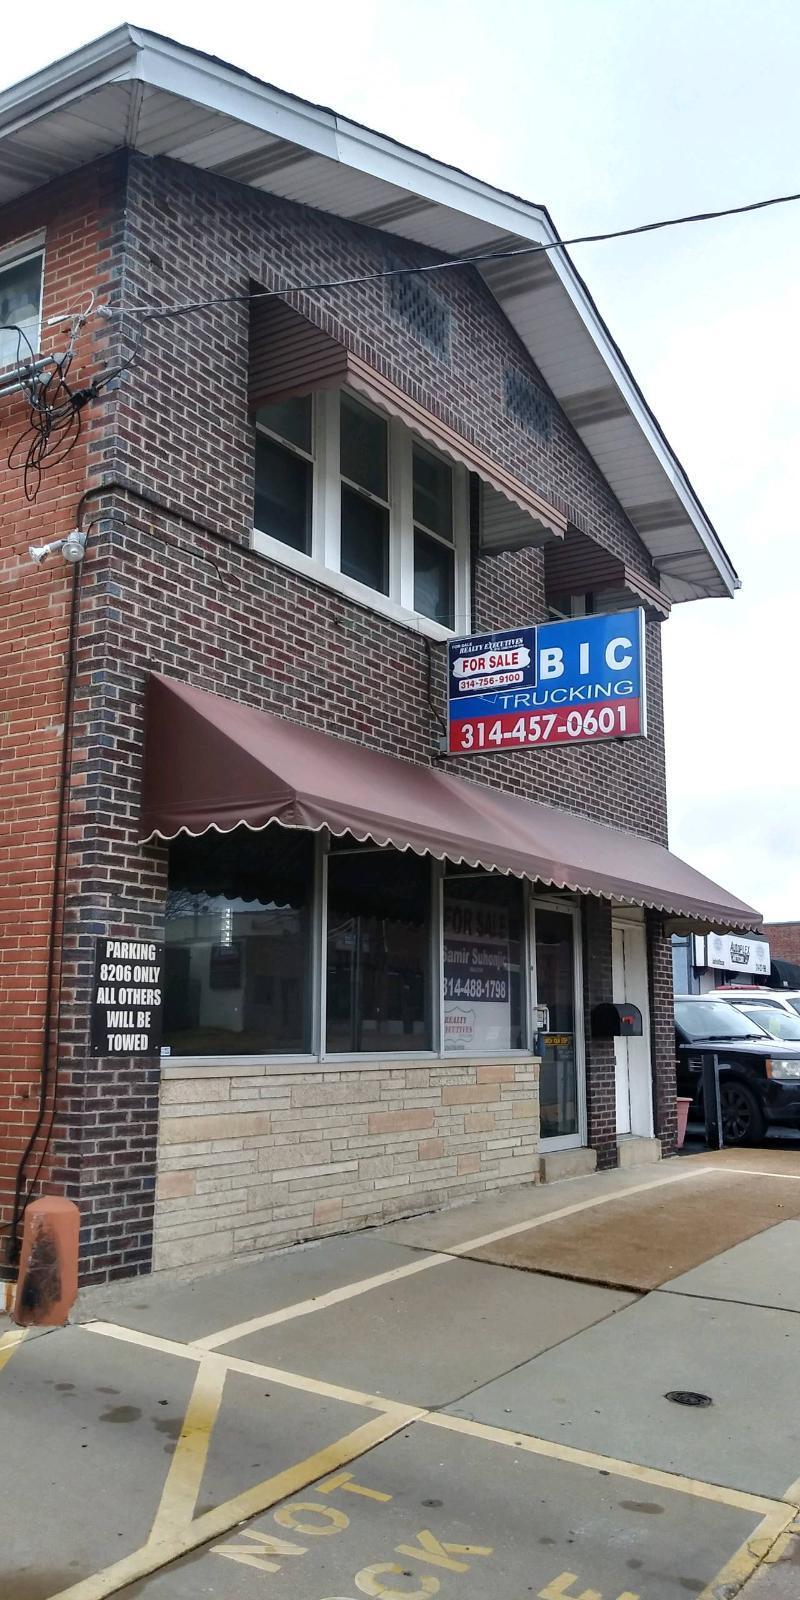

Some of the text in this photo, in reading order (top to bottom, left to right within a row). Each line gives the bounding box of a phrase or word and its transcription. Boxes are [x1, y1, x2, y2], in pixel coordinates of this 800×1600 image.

[459, 643, 482, 654] REALTY
[484, 637, 524, 652] EXECUTIVES
[462, 652, 519, 673] FOR SALE
[460, 673, 520, 689] 314-756-9100
[499, 680, 633, 710] TRUCKING
[460, 706, 627, 749] 314-457-0601
[105, 941, 157, 961] PARKING
[443, 946, 471, 965] Samir
[99, 963, 161, 983] 8206 ONLY
[96, 987, 162, 1006] ALL OTHERS
[443, 977, 506, 999] 314-488-1798
[106, 1010, 152, 1029] WILL BE
[106, 1034, 149, 1052] TOWED
[208, 1471, 393, 1574] NOT
